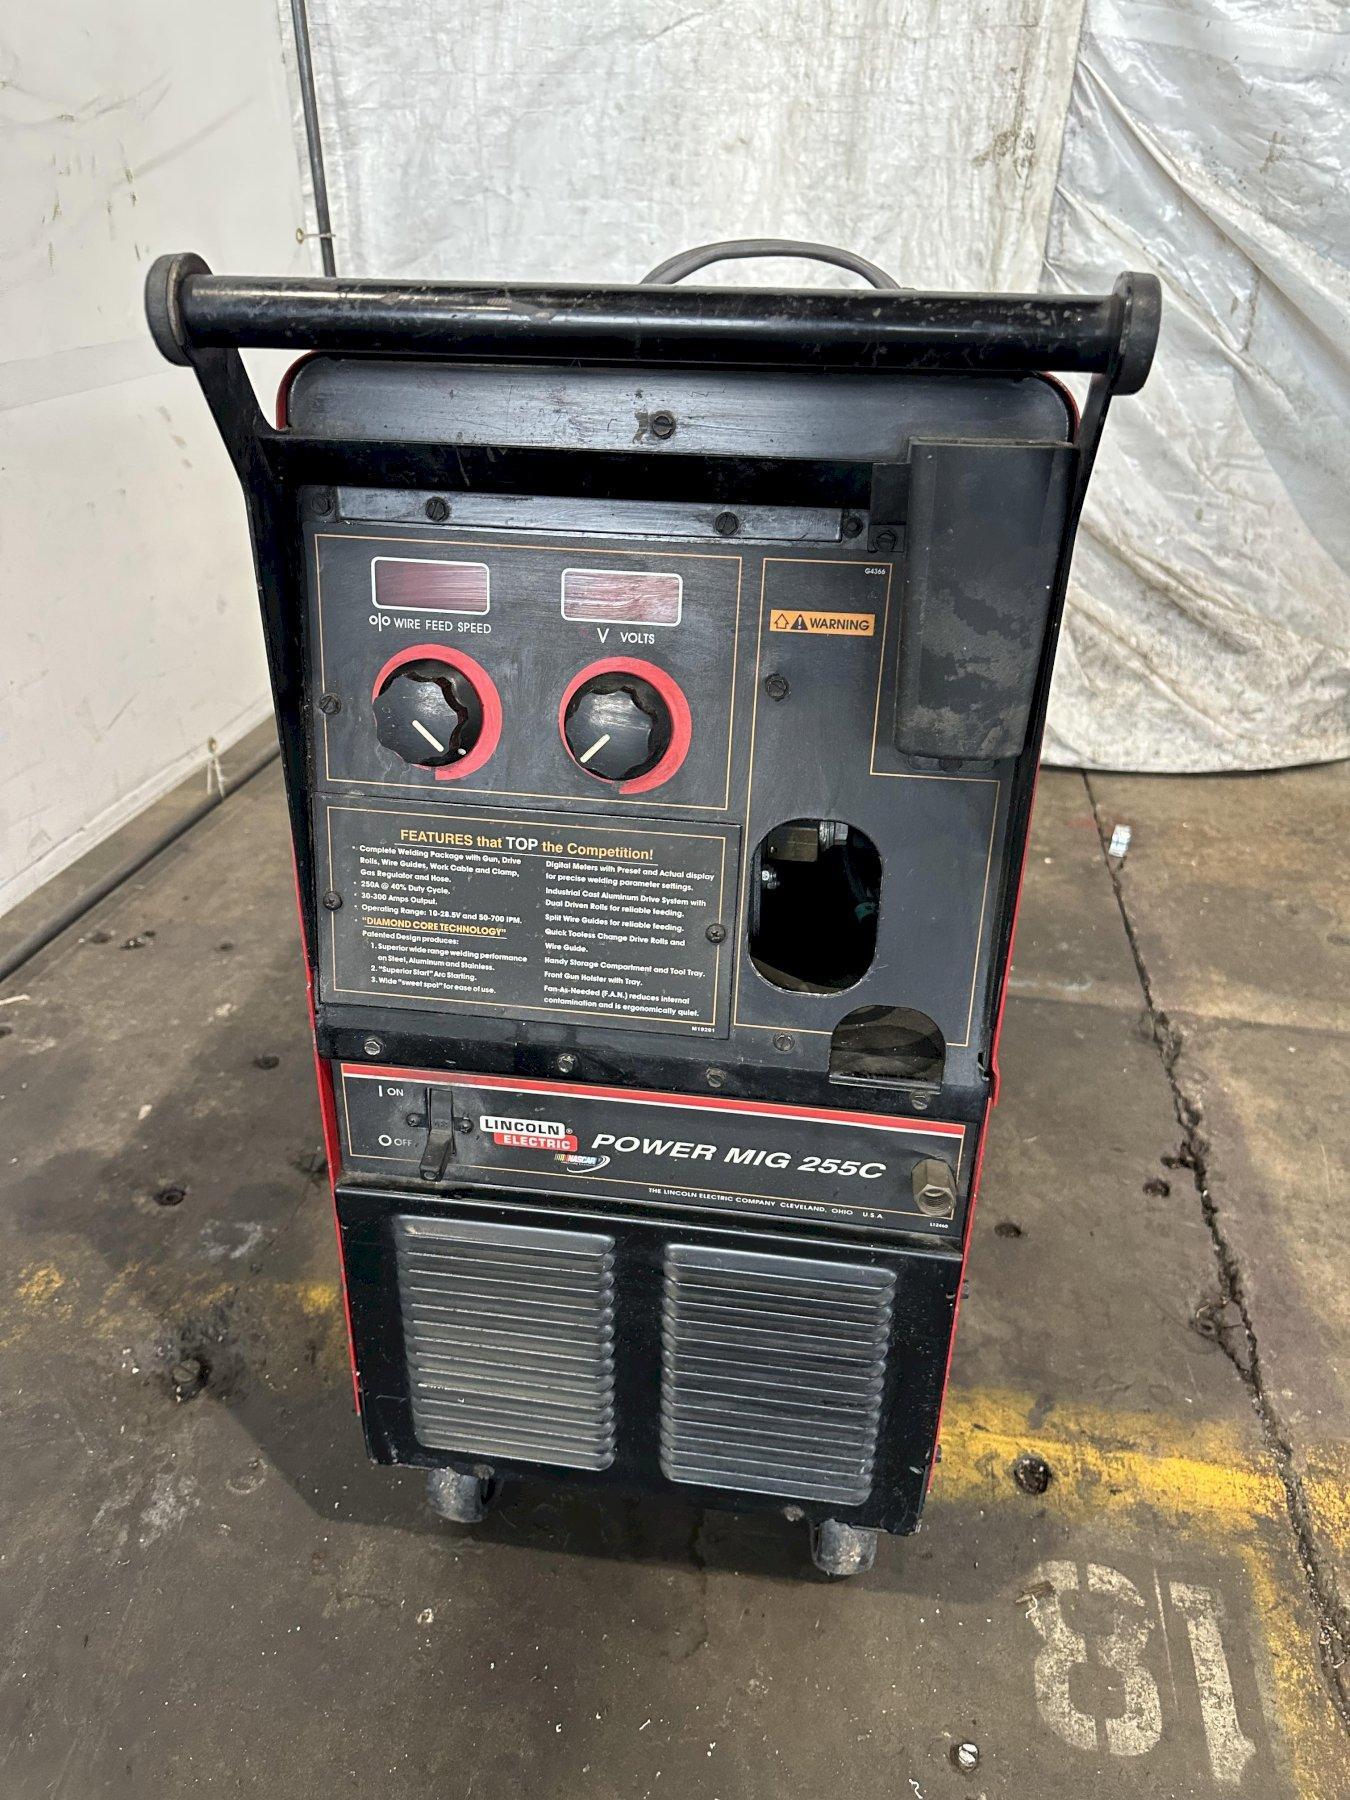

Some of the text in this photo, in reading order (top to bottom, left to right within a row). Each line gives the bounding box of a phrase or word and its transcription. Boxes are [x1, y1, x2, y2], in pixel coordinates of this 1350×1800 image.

[394, 619, 491, 633] WIRE FEED SPEED
[810, 618, 869, 630] WARNING
[620, 632, 654, 644] VOLTS
[401, 829, 653, 860] FEATURES that TOP the Competition!
[360, 845, 396, 854] Complete
[398, 848, 428, 858] Welding
[431, 852, 463, 861] Package
[483, 856, 500, 864] Gun,
[502, 857, 521, 865] Drive
[360, 857, 379, 866] Rolls,
[400, 860, 428, 870] Guides,
[451, 865, 473, 873] Cable
[492, 868, 519, 878] Clamp,
[377, 870, 412, 879] Regulator
[546, 861, 570, 869] Digital
[573, 863, 598, 871] Meters
[617, 866, 641, 875] Preset
[643, 868, 658, 876] and
[660, 870, 684, 878] Actual
[686, 872, 714, 881] display
[391, 883, 406, 891] 40%
[408, 885, 425, 893] Duty
[427, 886, 450, 895] Cycle.
[558, 874, 586, 883] precise
[588, 876, 618, 886] welding
[620, 880, 660, 889] parameter
[662, 882, 693, 892] settings.
[388, 895, 408, 903] Amps
[410, 897, 437, 905] Output.
[546, 887, 580, 896] Industrial
[582, 890, 600, 898] Cast
[601, 892, 638, 901] Aluminum
[662, 896, 688, 906] System
[690, 899, 706, 907] with
[362, 904, 398, 914] Operating
[401, 908, 426, 917] Range:
[462, 912, 477, 920] and
[479, 914, 504, 922] 50-700
[506, 916, 522, 924] IPM.
[565, 901, 588, 909] Driven
[622, 905, 651, 914] reliable
[653, 908, 684, 918] feeding.
[413, 922, 438, 930] CORE
[545, 914, 561, 922] Split
[582, 917, 608, 925] Guides
[622, 920, 651, 929] reliable
[653, 923, 684, 932] feeding.
[362, 930, 459, 945] Patented Design produces:
[545, 928, 567, 936] Quick
[569, 930, 595, 939] Tooless
[597, 932, 627, 942] Change
[378, 943, 408, 952] Superior
[450, 950, 479, 960] welding
[480, 953, 527, 962] performance
[564, 944, 588, 952] Guide.
[388, 955, 408, 964] Steel,
[409, 957, 444, 966] Aluminum
[446, 960, 459, 968] and
[461, 961, 495, 970] Stainless.
[545, 957, 568, 966] Handy
[570, 959, 598, 968] Storage
[600, 962, 651, 973] Compartment
[687, 969, 705, 978] Tray.
[447, 972, 476, 982] Starting.
[545, 971, 562, 979] Front
[581, 974, 607, 983] Holster
[625, 978, 642, 986] Tray.
[544, 985, 689, 1004] Fan-As-Needed (F.A.N.) reduces internal
[544, 997, 597, 1007] contamination
[623, 1004, 676, 1015] ergonomically
[678, 1009, 699, 1017] quiet.
[388, 1088, 404, 1096] ON
[485, 1119, 560, 1135] LINCOLN
[394, 1138, 411, 1147] OFF
[503, 1135, 571, 1150] ELECTRIC
[566, 1155, 596, 1165] NASCAR
[591, 1134, 887, 1178] POWER MIG 255C
[664, 1189, 697, 1198] LINCOLN
[699, 1193, 733, 1202] ELECTRIC
[736, 1198, 775, 1207] COMPANY
[832, 1208, 853, 1216] OHIO
